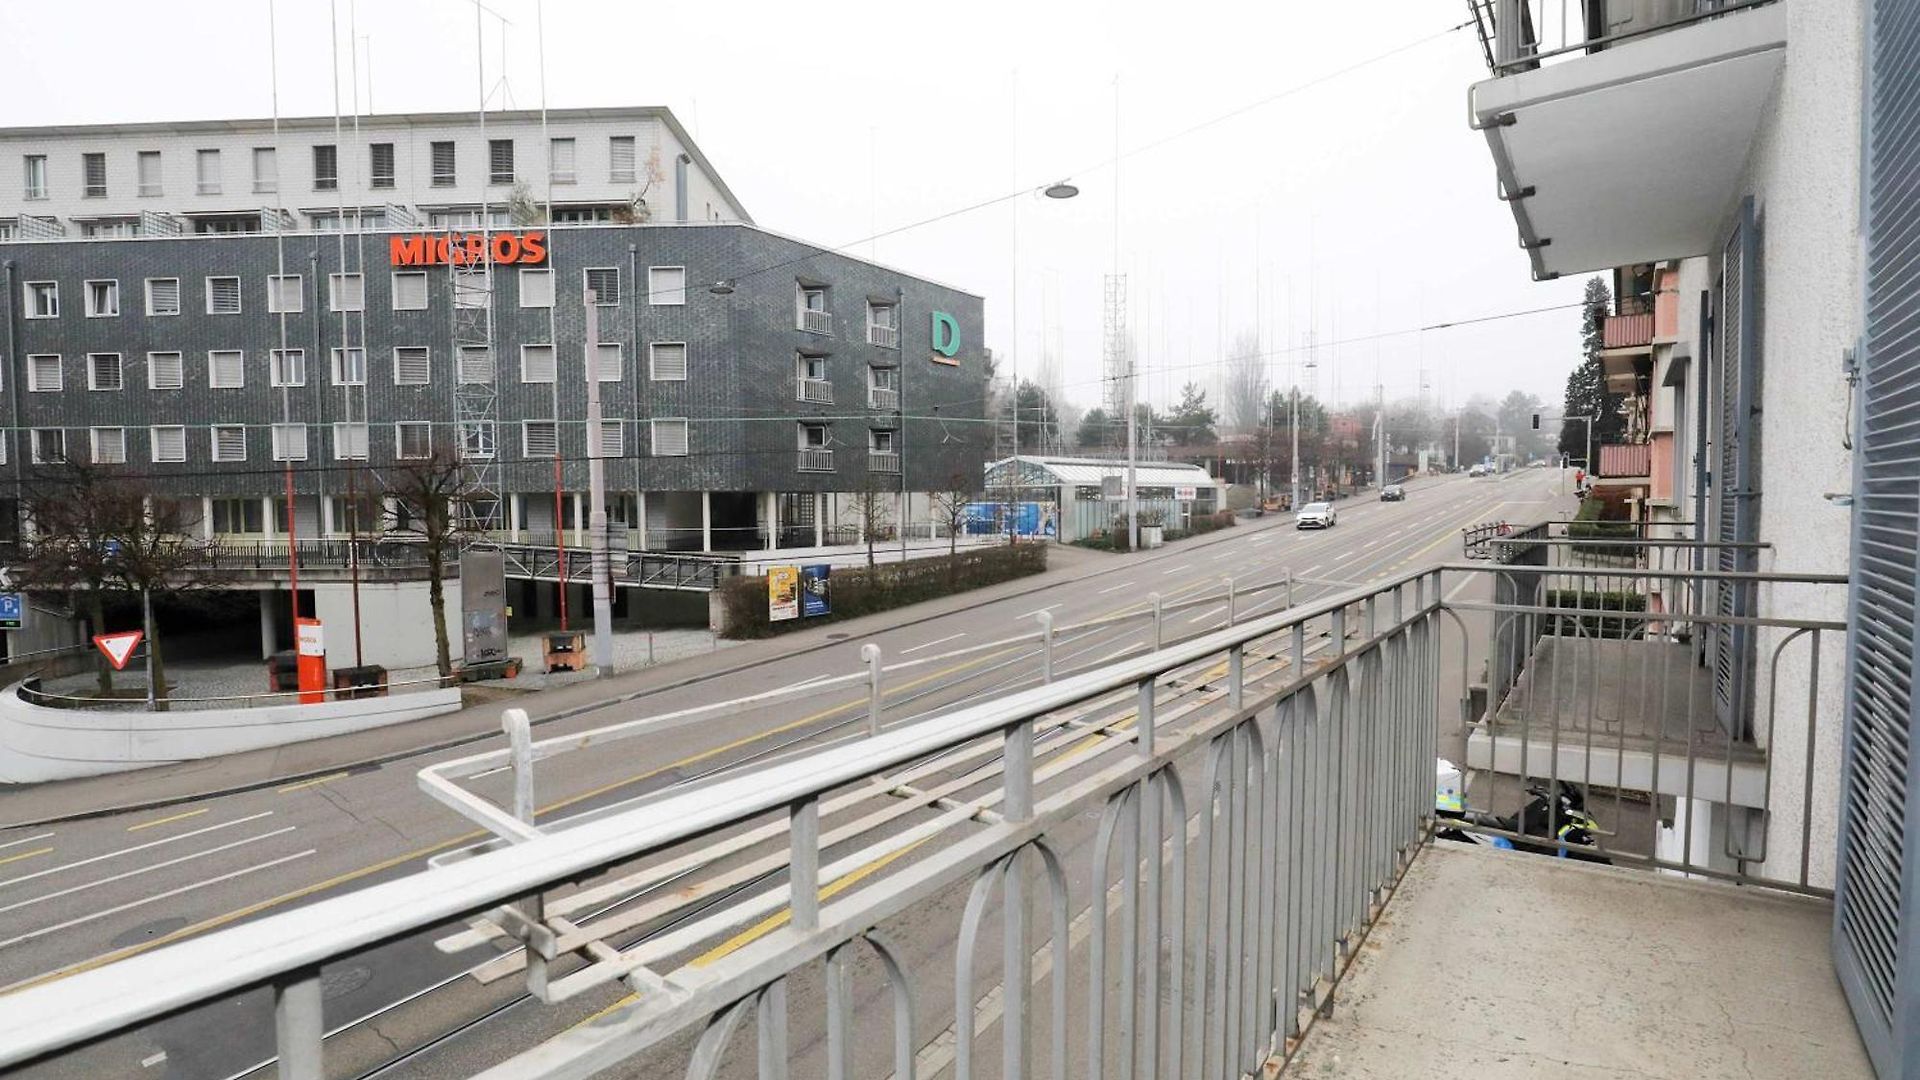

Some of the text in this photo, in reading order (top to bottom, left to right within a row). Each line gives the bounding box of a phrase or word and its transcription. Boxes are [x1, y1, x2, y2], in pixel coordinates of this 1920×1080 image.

[390, 233, 547, 265] MIGROS
[932, 311, 960, 357] D
[4, 600, 12, 612] P
